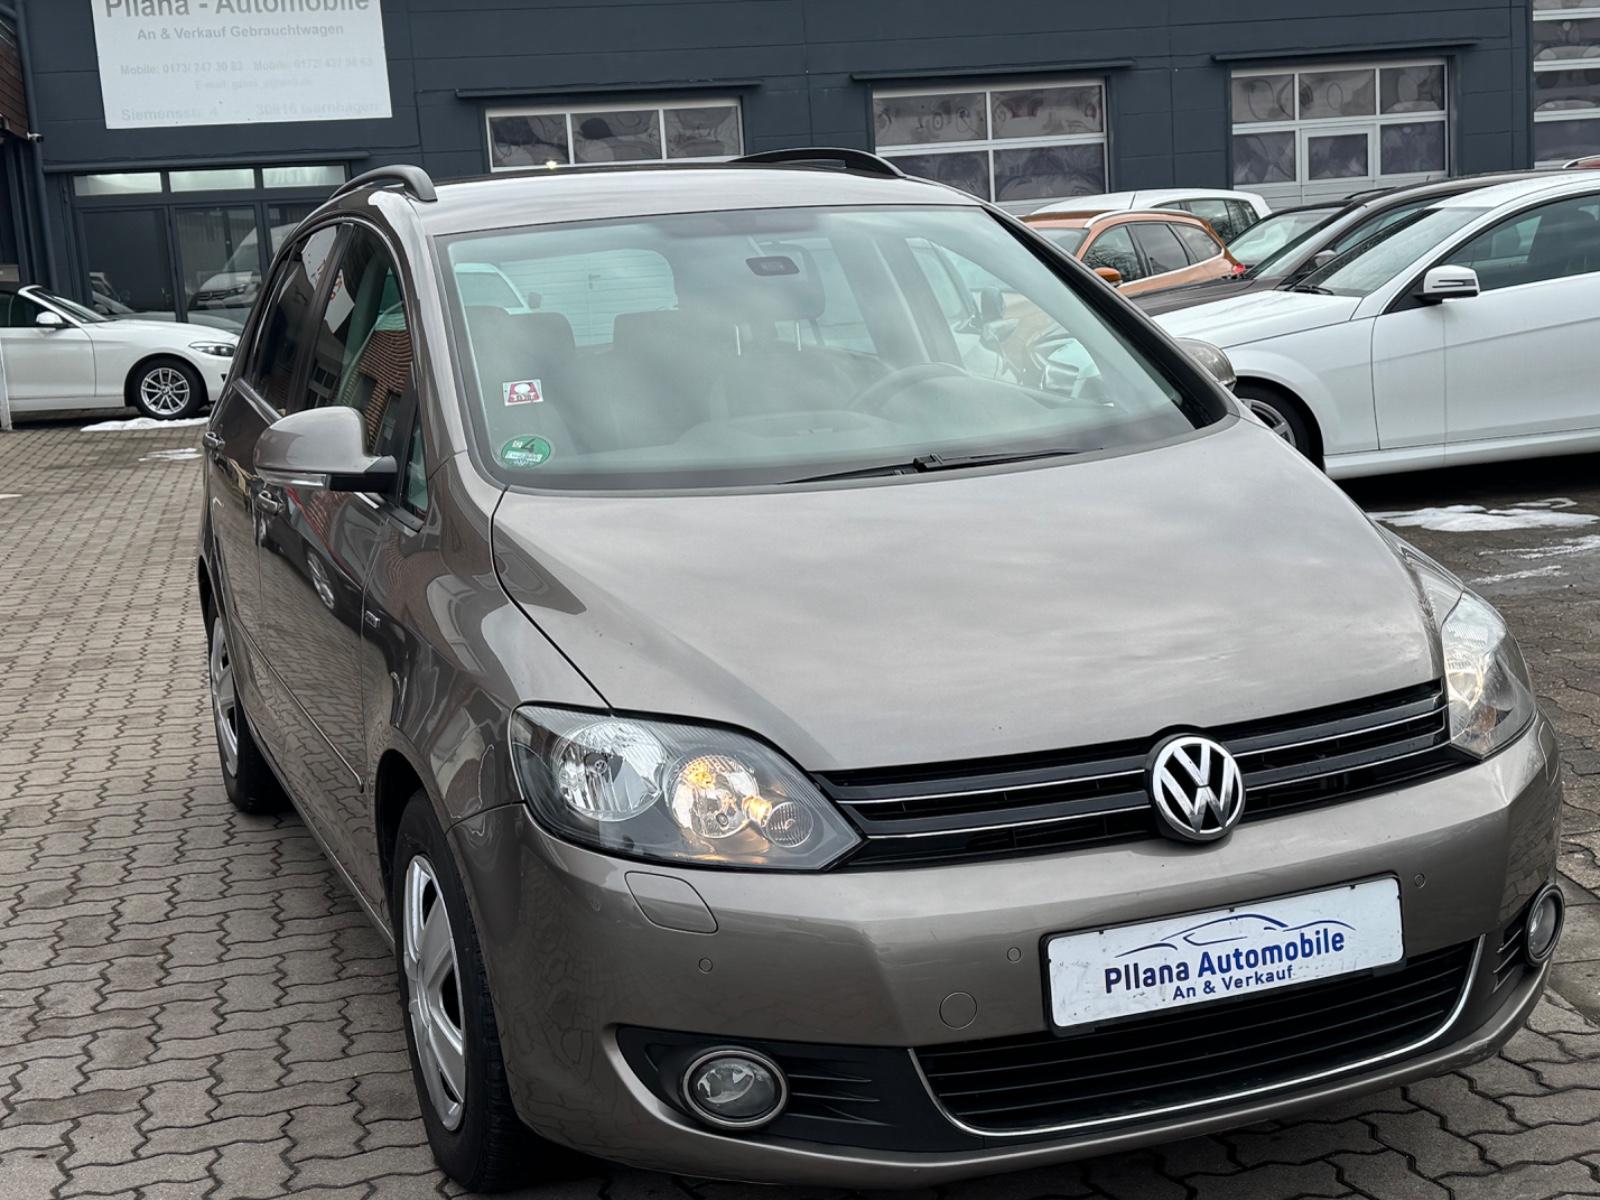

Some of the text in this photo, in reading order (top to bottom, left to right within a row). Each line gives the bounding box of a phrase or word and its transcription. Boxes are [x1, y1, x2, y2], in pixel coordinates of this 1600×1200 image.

[215, 0, 370, 15] Automobile
[137, 24, 344, 41] An & Verkauf Gebrauchtwagen
[1160, 743, 1235, 833] VW
[1198, 929, 1345, 978] Automobile
[1173, 965, 1294, 1000] An & Verkauf
